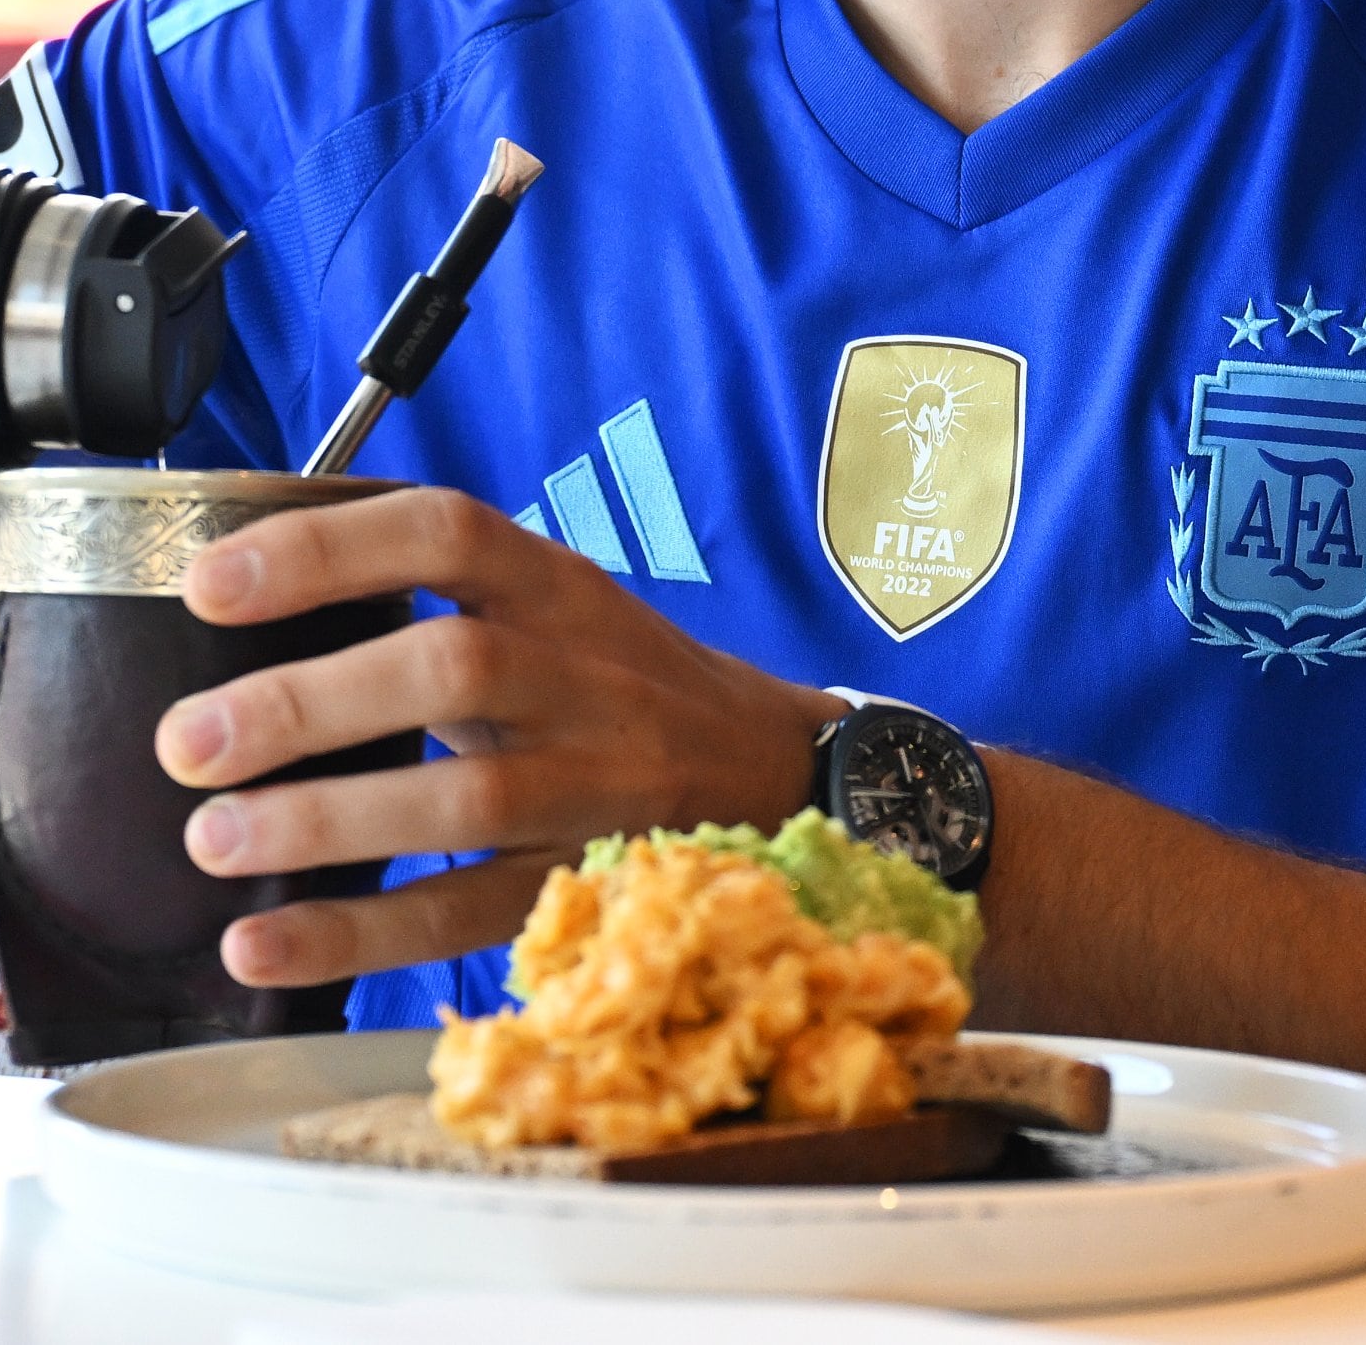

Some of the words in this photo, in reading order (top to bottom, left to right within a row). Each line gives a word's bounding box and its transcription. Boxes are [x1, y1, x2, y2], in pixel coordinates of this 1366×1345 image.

[1225, 447, 1364, 593] AFA
[849, 555, 895, 571] WORLD
[897, 560, 973, 580] CHAMPIONS
[881, 574, 933, 597] 2022
